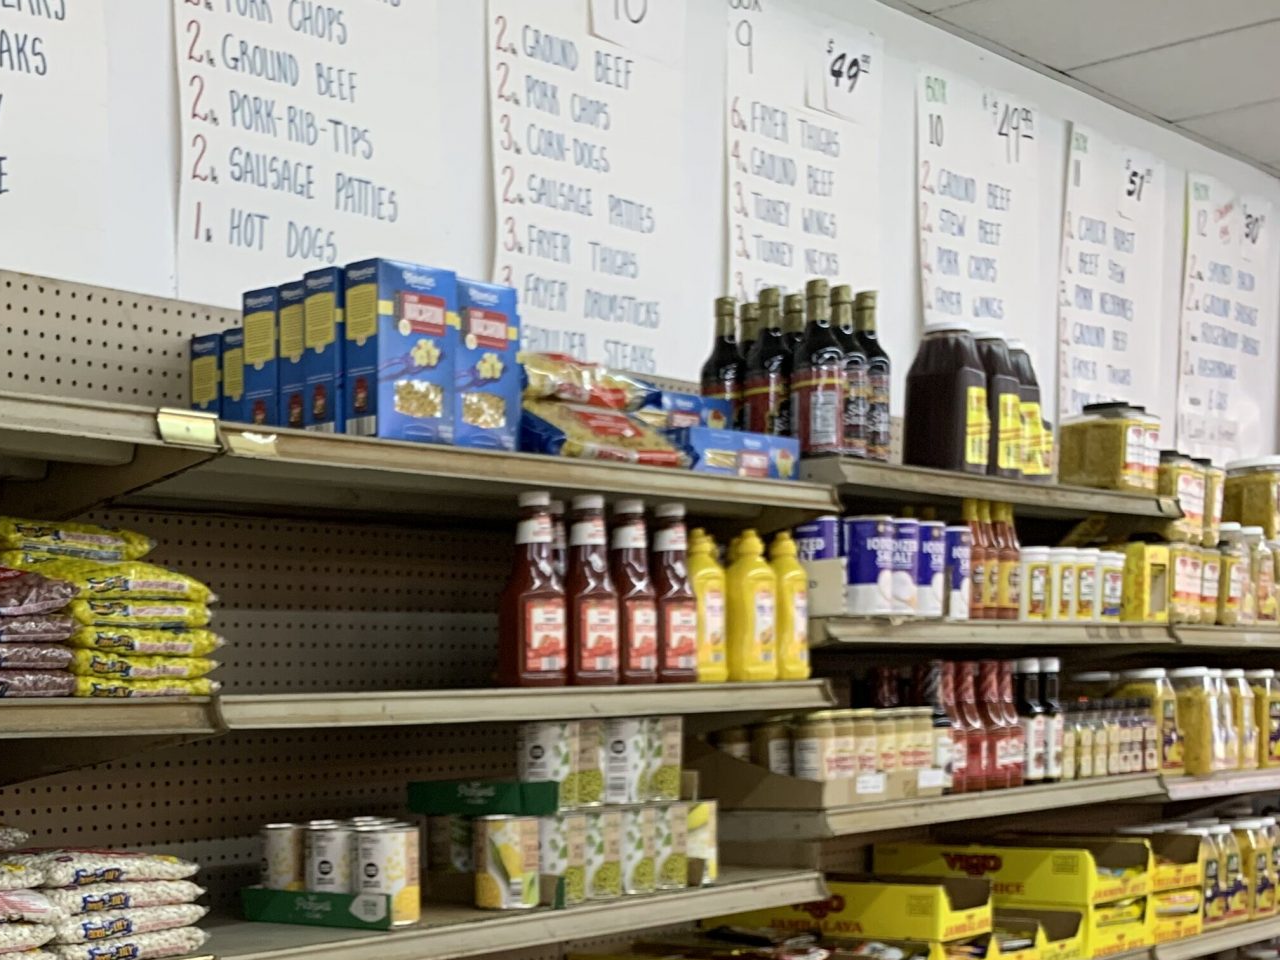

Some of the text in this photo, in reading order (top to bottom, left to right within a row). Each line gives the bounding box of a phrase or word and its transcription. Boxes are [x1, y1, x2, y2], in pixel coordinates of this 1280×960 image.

[288, 0, 347, 44] CHOPS
[222, 34, 358, 103] GROUND BEEF
[522, 24, 633, 90] GROUND BEEF
[525, 75, 611, 130] PORK CHOPS
[229, 147, 398, 222] SAUSAGE PATTIES
[528, 173, 655, 233] SAUSAGE PATTIES
[229, 208, 337, 263] HOT DOGS
[528, 224, 639, 279] FRYER THIGHS
[524, 273, 660, 328] FRYER DRUMSTICKS
